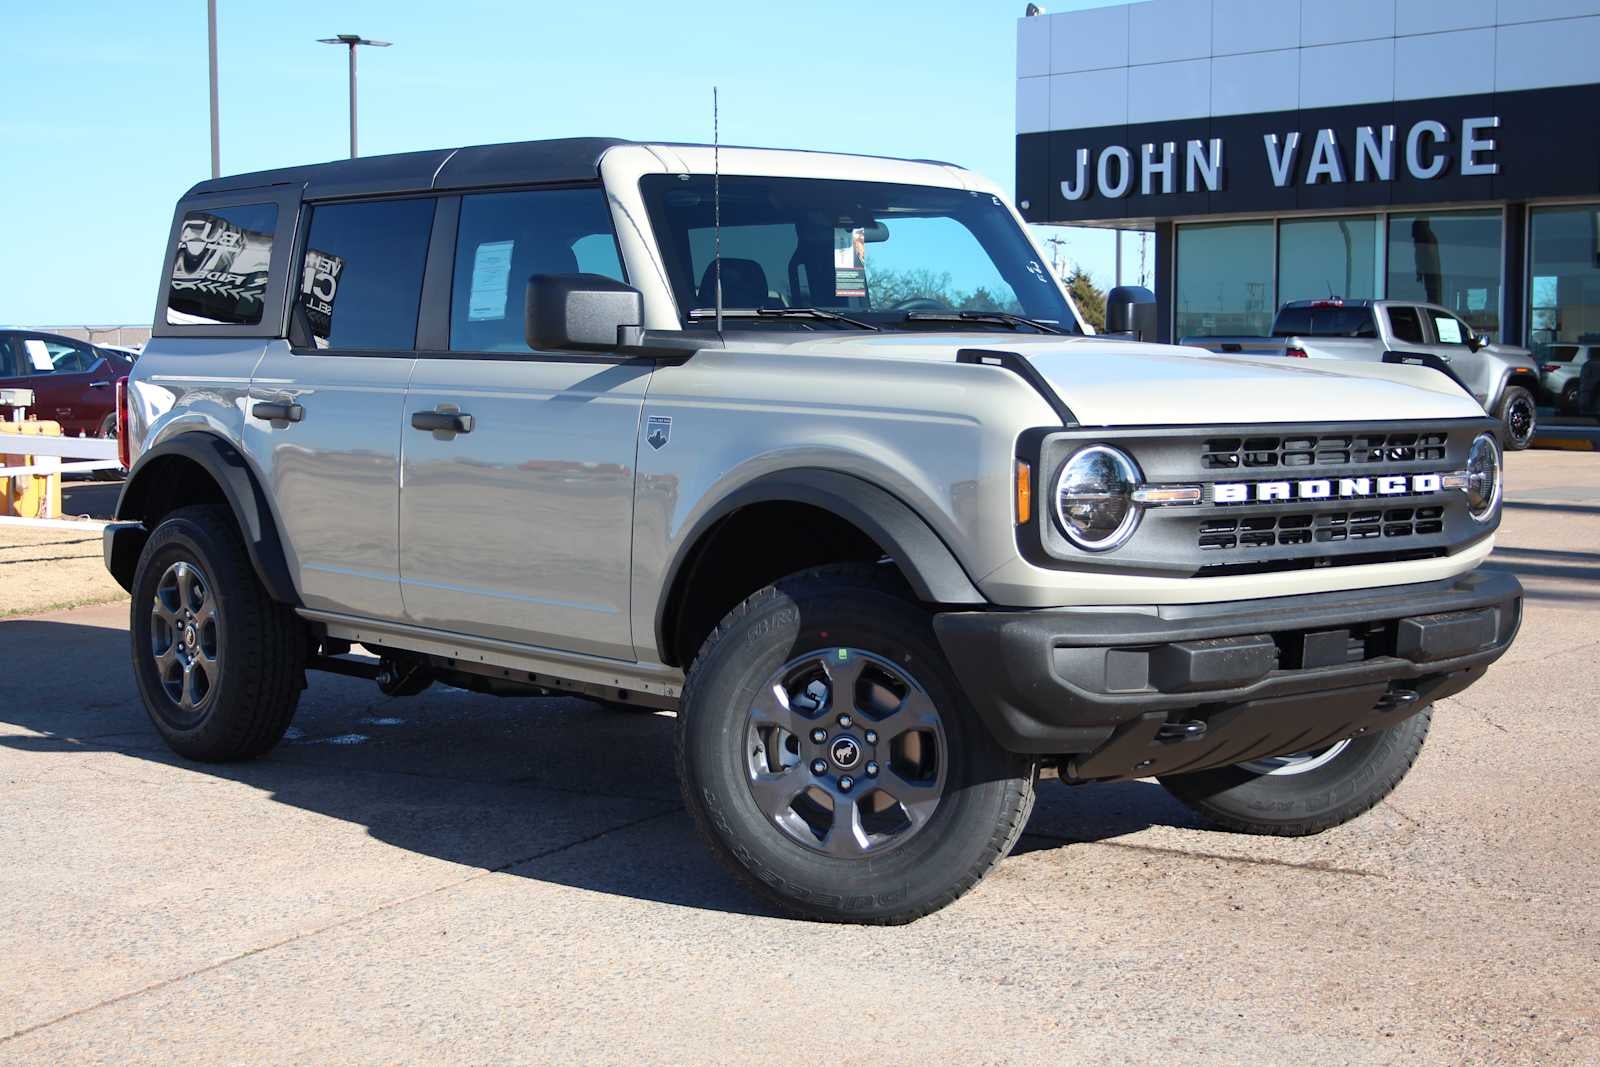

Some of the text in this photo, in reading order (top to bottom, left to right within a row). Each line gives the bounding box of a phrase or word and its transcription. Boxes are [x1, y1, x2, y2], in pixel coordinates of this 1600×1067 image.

[1061, 116, 1501, 201] JOHN VANCE
[1214, 473, 1442, 504] BRONCO
